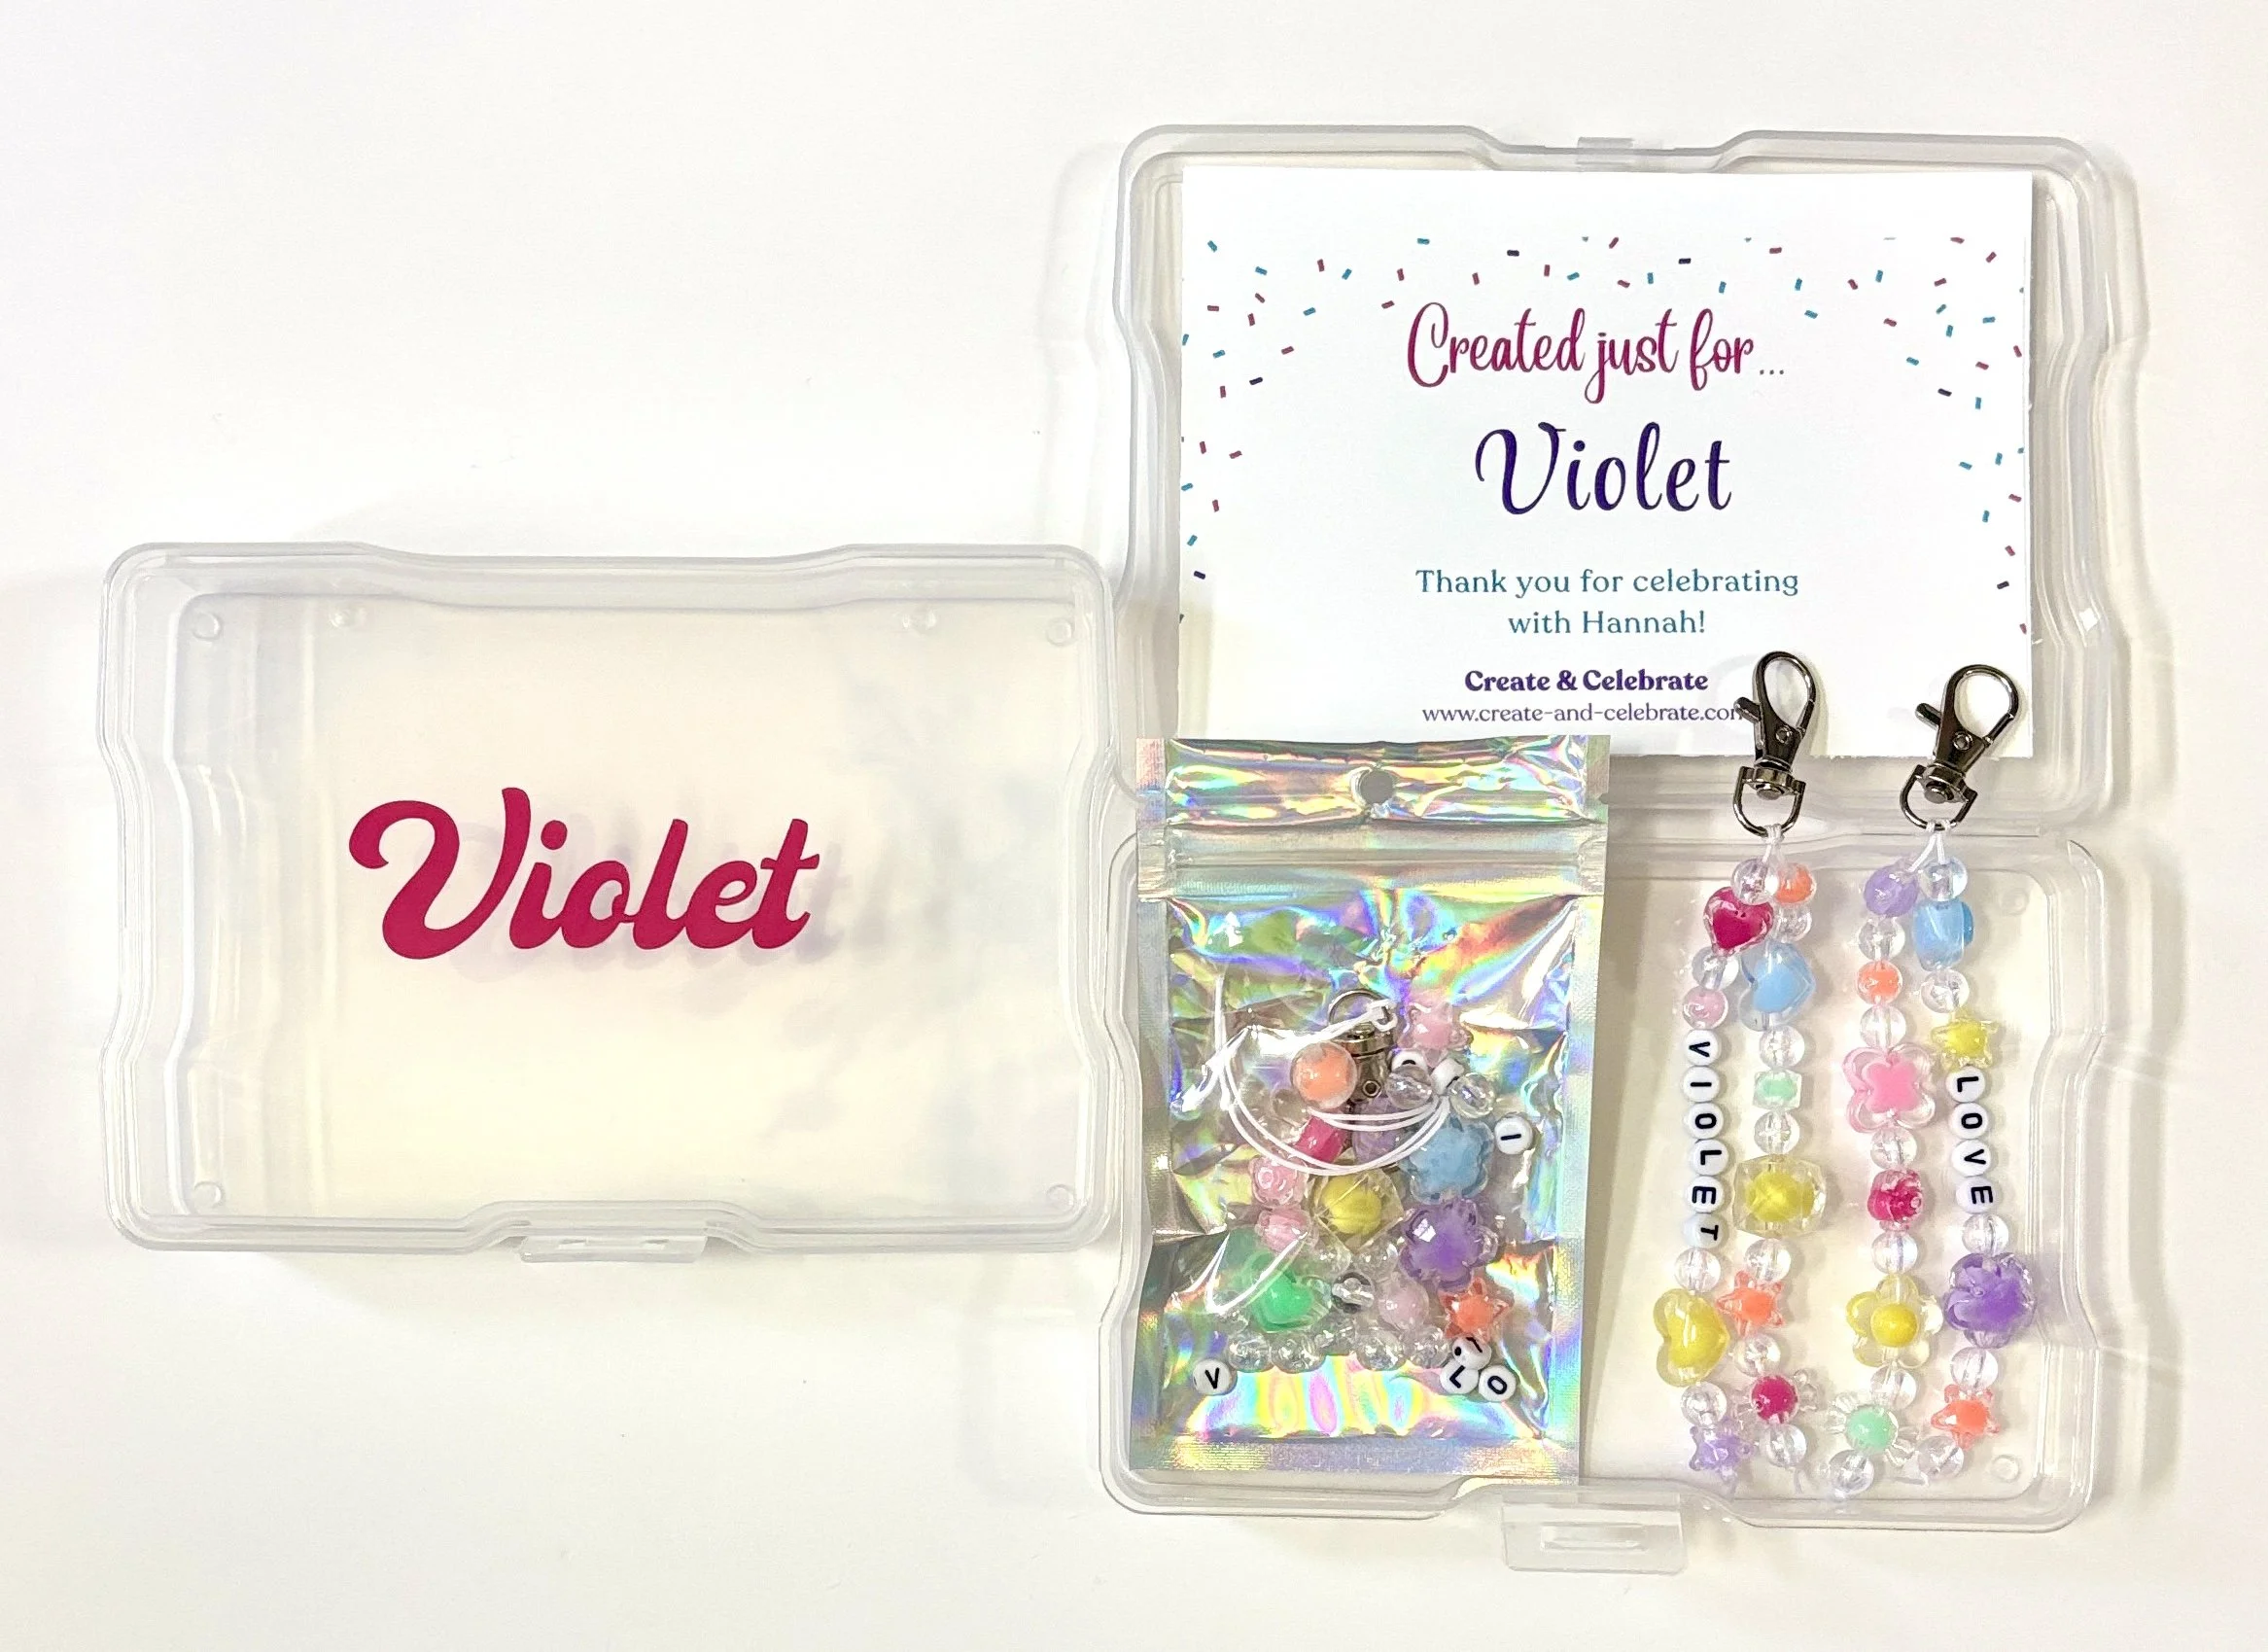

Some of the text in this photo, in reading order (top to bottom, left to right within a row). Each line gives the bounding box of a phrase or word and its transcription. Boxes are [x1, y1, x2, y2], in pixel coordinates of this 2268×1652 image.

[1407, 301, 1586, 388] Created
[1585, 307, 1679, 404] just
[1475, 421, 1732, 515] Violet
[1414, 568, 1798, 599] Thank you for celebrating
[1508, 609, 1706, 634] with Hannah!
[1464, 668, 1709, 692] Create & Celebrate
[348, 787, 820, 961] Violet
[1689, 1041, 1723, 1242] VIOLET
[1956, 1075, 1994, 1205] LOVE
[1204, 1367, 1220, 1389] V
[1448, 1364, 1466, 1389] L
[1486, 1375, 1508, 1395] O
